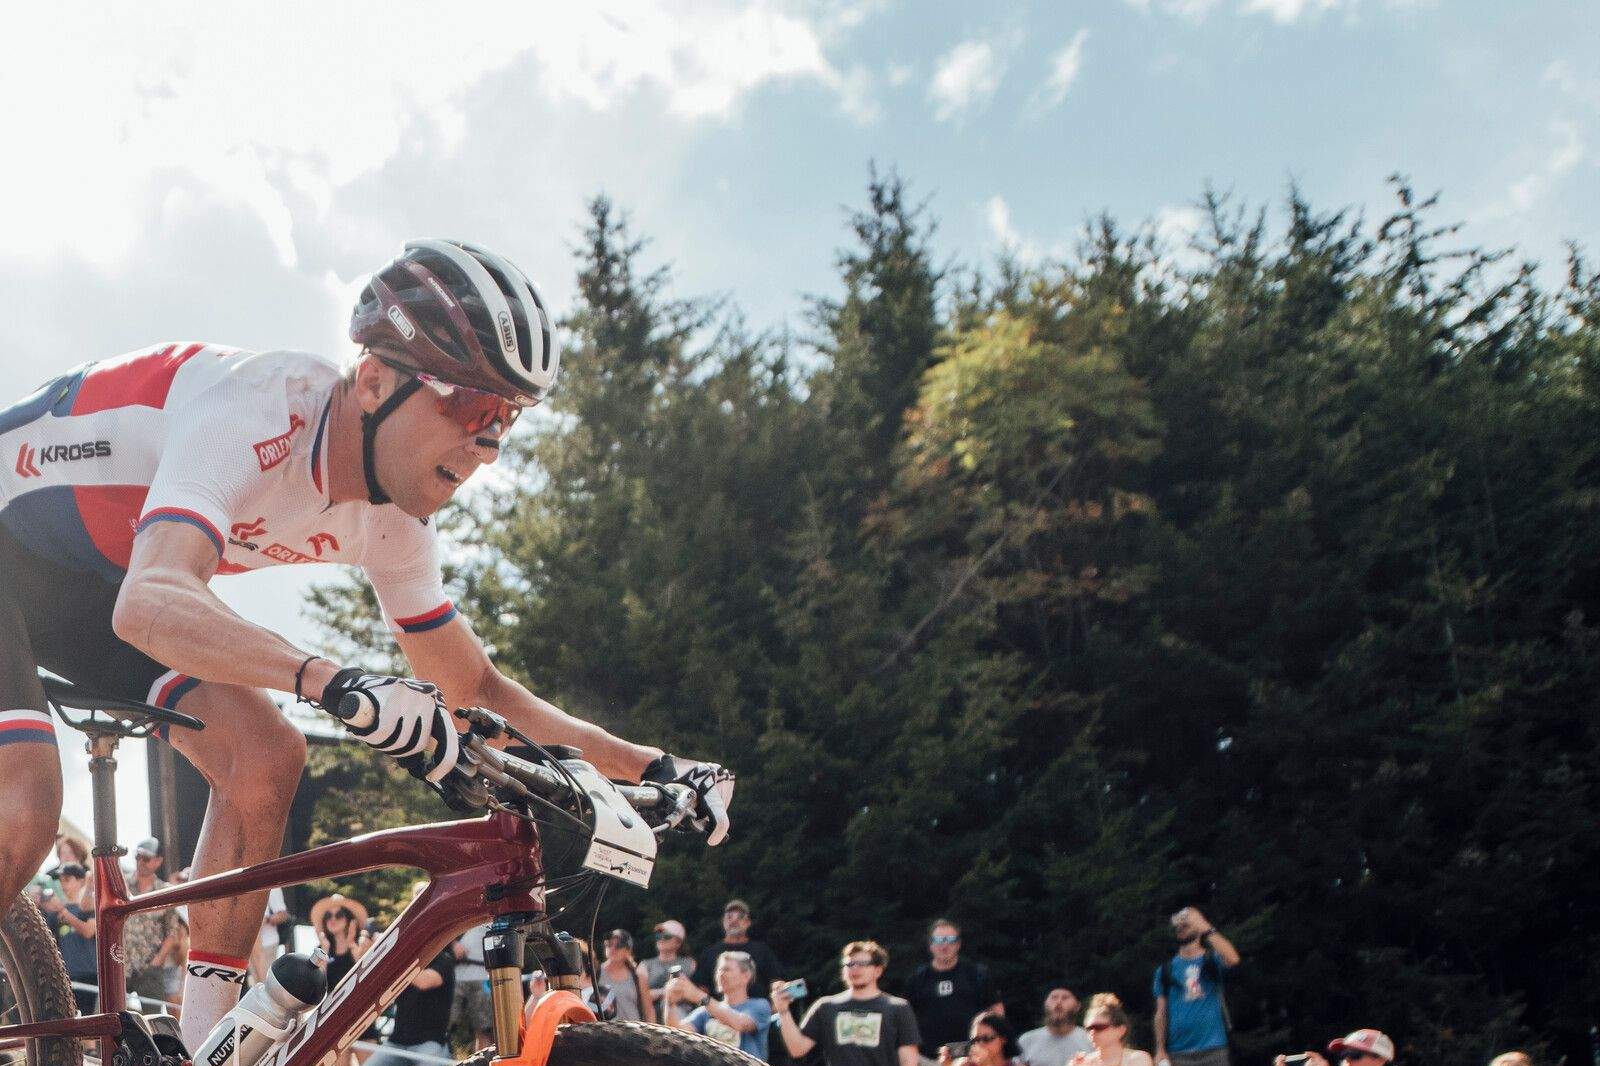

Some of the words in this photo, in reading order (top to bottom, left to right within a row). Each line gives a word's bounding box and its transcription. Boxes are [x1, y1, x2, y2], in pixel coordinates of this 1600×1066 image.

[500, 317, 514, 347] ABUS
[40, 440, 112, 466] KROSS
[213, 1024, 250, 1066] NUTRN
